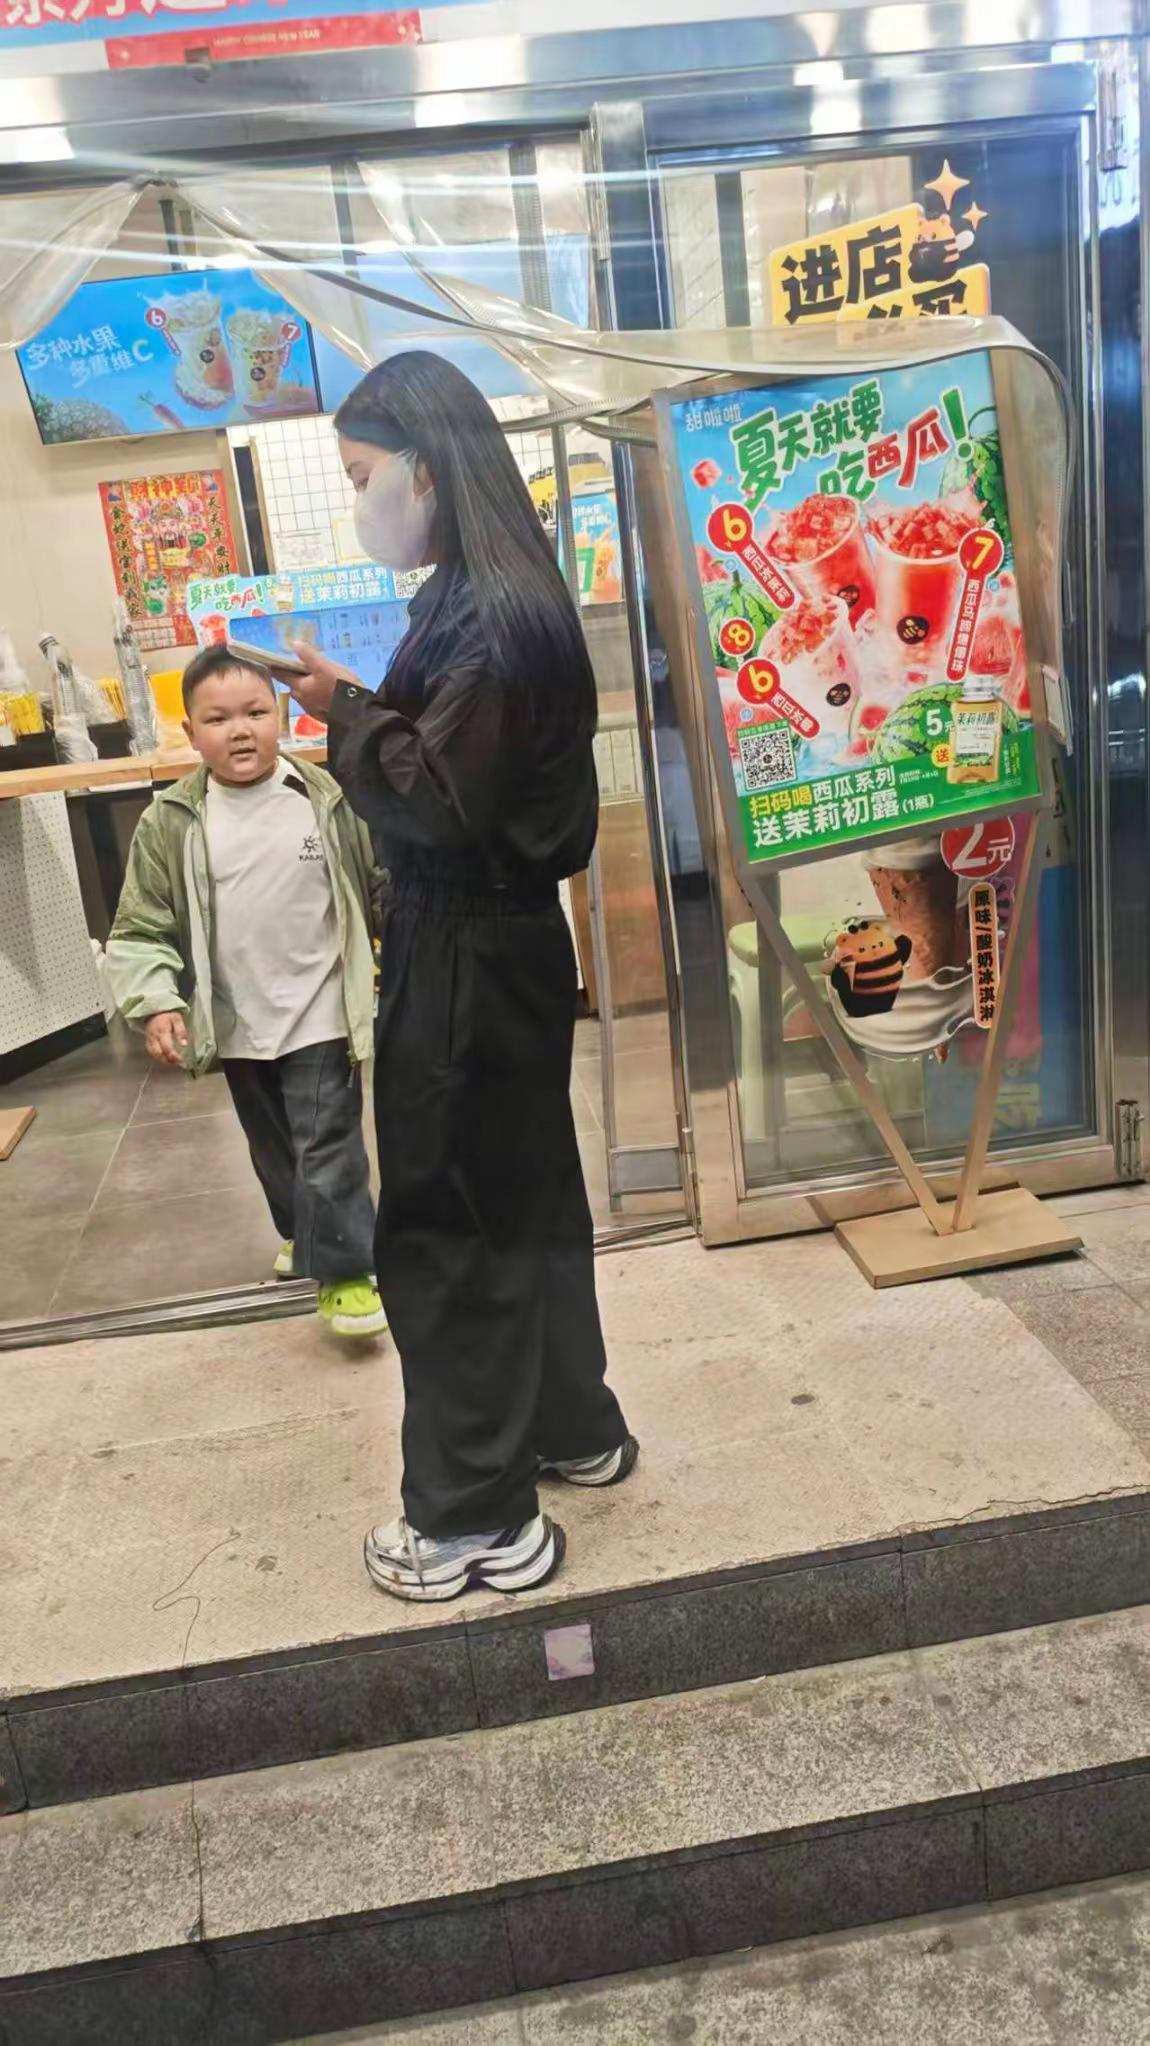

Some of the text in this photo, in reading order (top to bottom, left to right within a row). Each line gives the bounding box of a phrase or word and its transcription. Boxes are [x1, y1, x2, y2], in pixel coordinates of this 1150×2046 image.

[781, 225, 902, 325] 进店
[151, 310, 164, 325] 6
[26, 325, 122, 370] 多种水果
[731, 380, 882, 511] 夏天就要
[723, 509, 747, 542] 6
[975, 536, 995, 570] 7
[728, 624, 750, 646] 8
[748, 664, 774, 693] 6
[935, 747, 950, 763] 送
[750, 765, 896, 819] 扫码喝西瓜系列
[753, 788, 900, 849] 送茉莉初露
